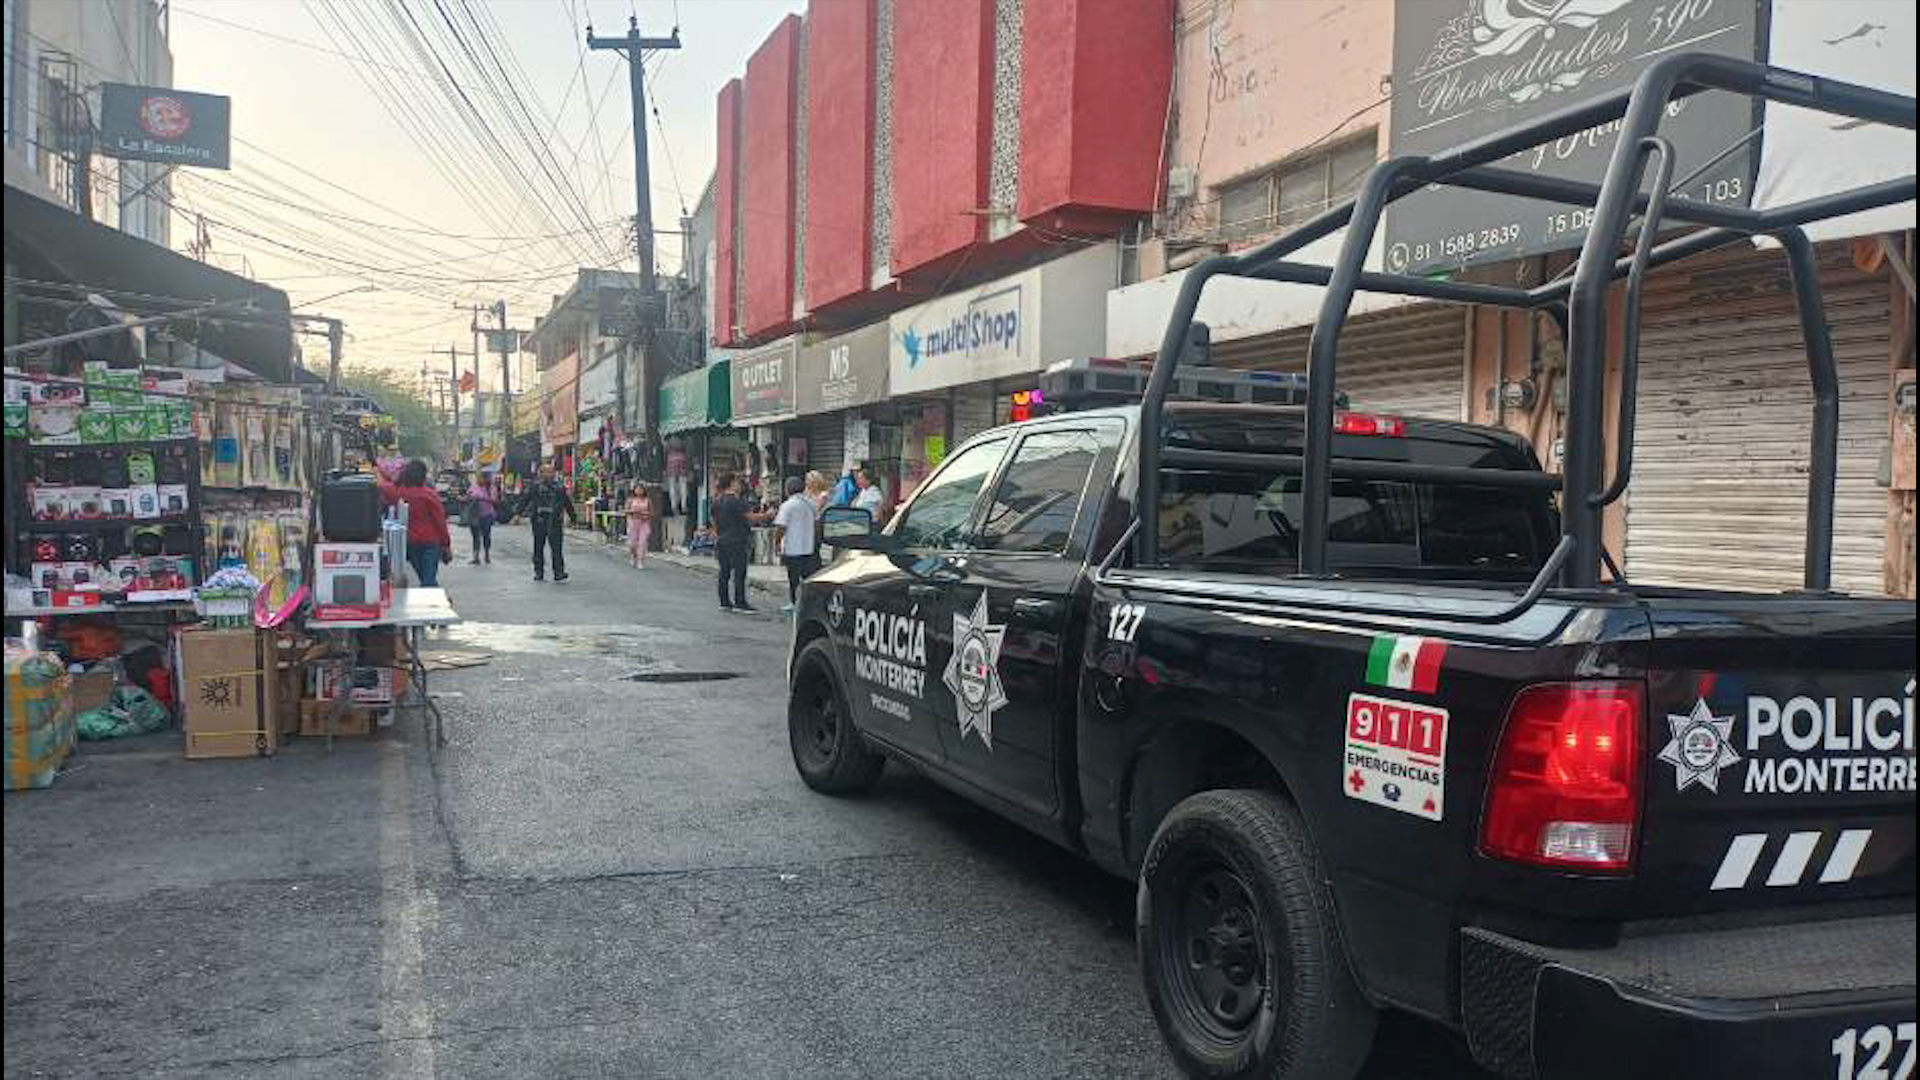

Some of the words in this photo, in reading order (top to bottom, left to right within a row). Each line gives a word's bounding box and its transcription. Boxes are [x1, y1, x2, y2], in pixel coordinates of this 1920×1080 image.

[1418, 18, 1631, 115] Novedades
[1647, 0, 1712, 43] 590
[119, 137, 138, 151] La
[1703, 178, 1742, 204] 103
[1414, 242, 1431, 261] 81
[1479, 224, 1520, 248] 2839
[742, 358, 782, 387] OUTLET
[829, 344, 849, 380] MB
[854, 603, 926, 666] POLICÍA
[1107, 604, 1146, 642] 127
[855, 652, 925, 699] MONTERREY
[1355, 707, 1435, 749] 911
[1347, 752, 1440, 786] EMERGENCIAS
